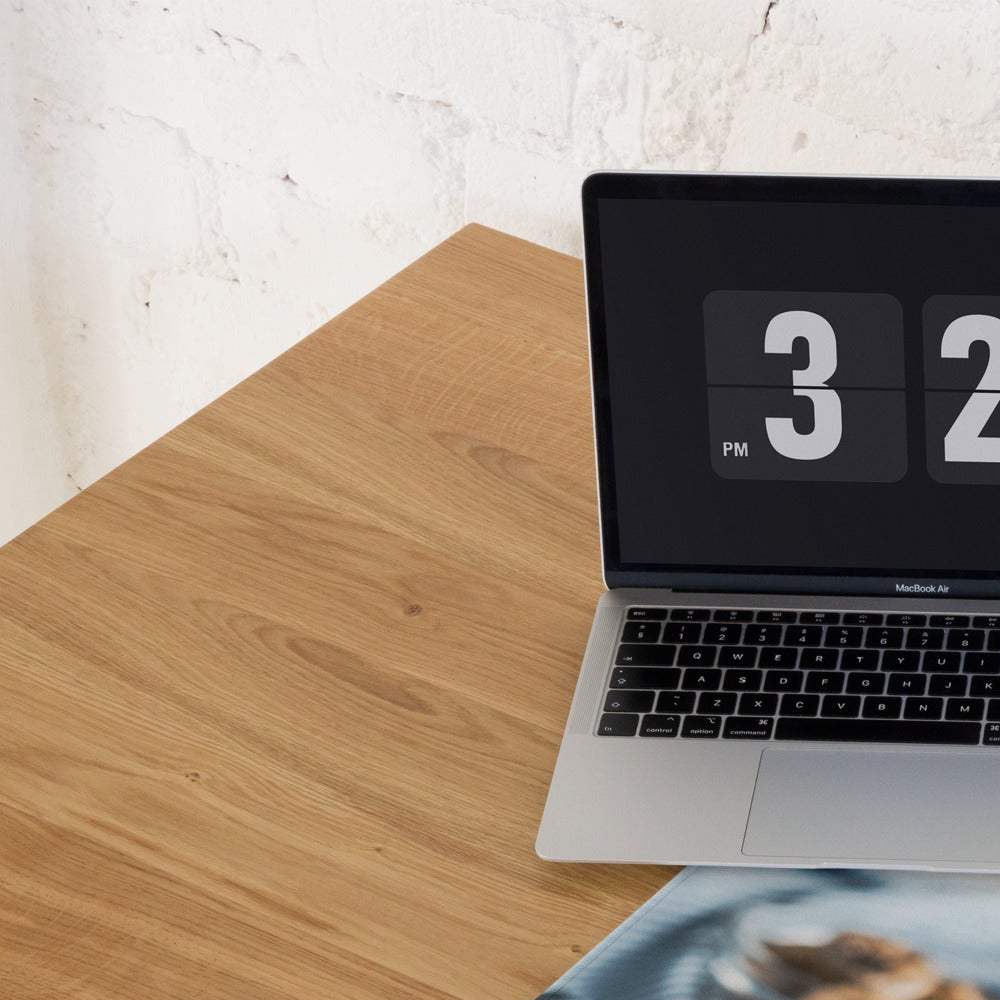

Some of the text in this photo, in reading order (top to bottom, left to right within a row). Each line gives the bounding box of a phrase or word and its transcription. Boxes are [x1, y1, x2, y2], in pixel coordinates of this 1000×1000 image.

[763, 310, 843, 460] 3
[723, 442, 749, 457] PM
[895, 583, 950, 593] MacBook Air
[718, 633, 726, 641] 2
[758, 634, 767, 642] 3
[960, 639, 970, 647] 8
[692, 651, 702, 661] Q
[732, 653, 745, 661] W
[774, 653, 782, 662] E
[814, 654, 824, 662] R
[856, 655, 864, 664] T
[897, 657, 905, 665] Y
[937, 657, 947, 666] U
[696, 675, 706, 683] A
[738, 676, 747, 684] S
[779, 677, 789, 685] D
[861, 679, 871, 687] G
[902, 680, 912, 688] H
[944, 681, 952, 689] J
[984, 682, 993, 690] K
[712, 698, 722, 707] Z
[753, 700, 763, 708] X
[795, 700, 805, 709] C
[837, 702, 846, 710] V
[877, 703, 887, 711] B
[918, 704, 929, 712] N
[959, 705, 971, 713] M
